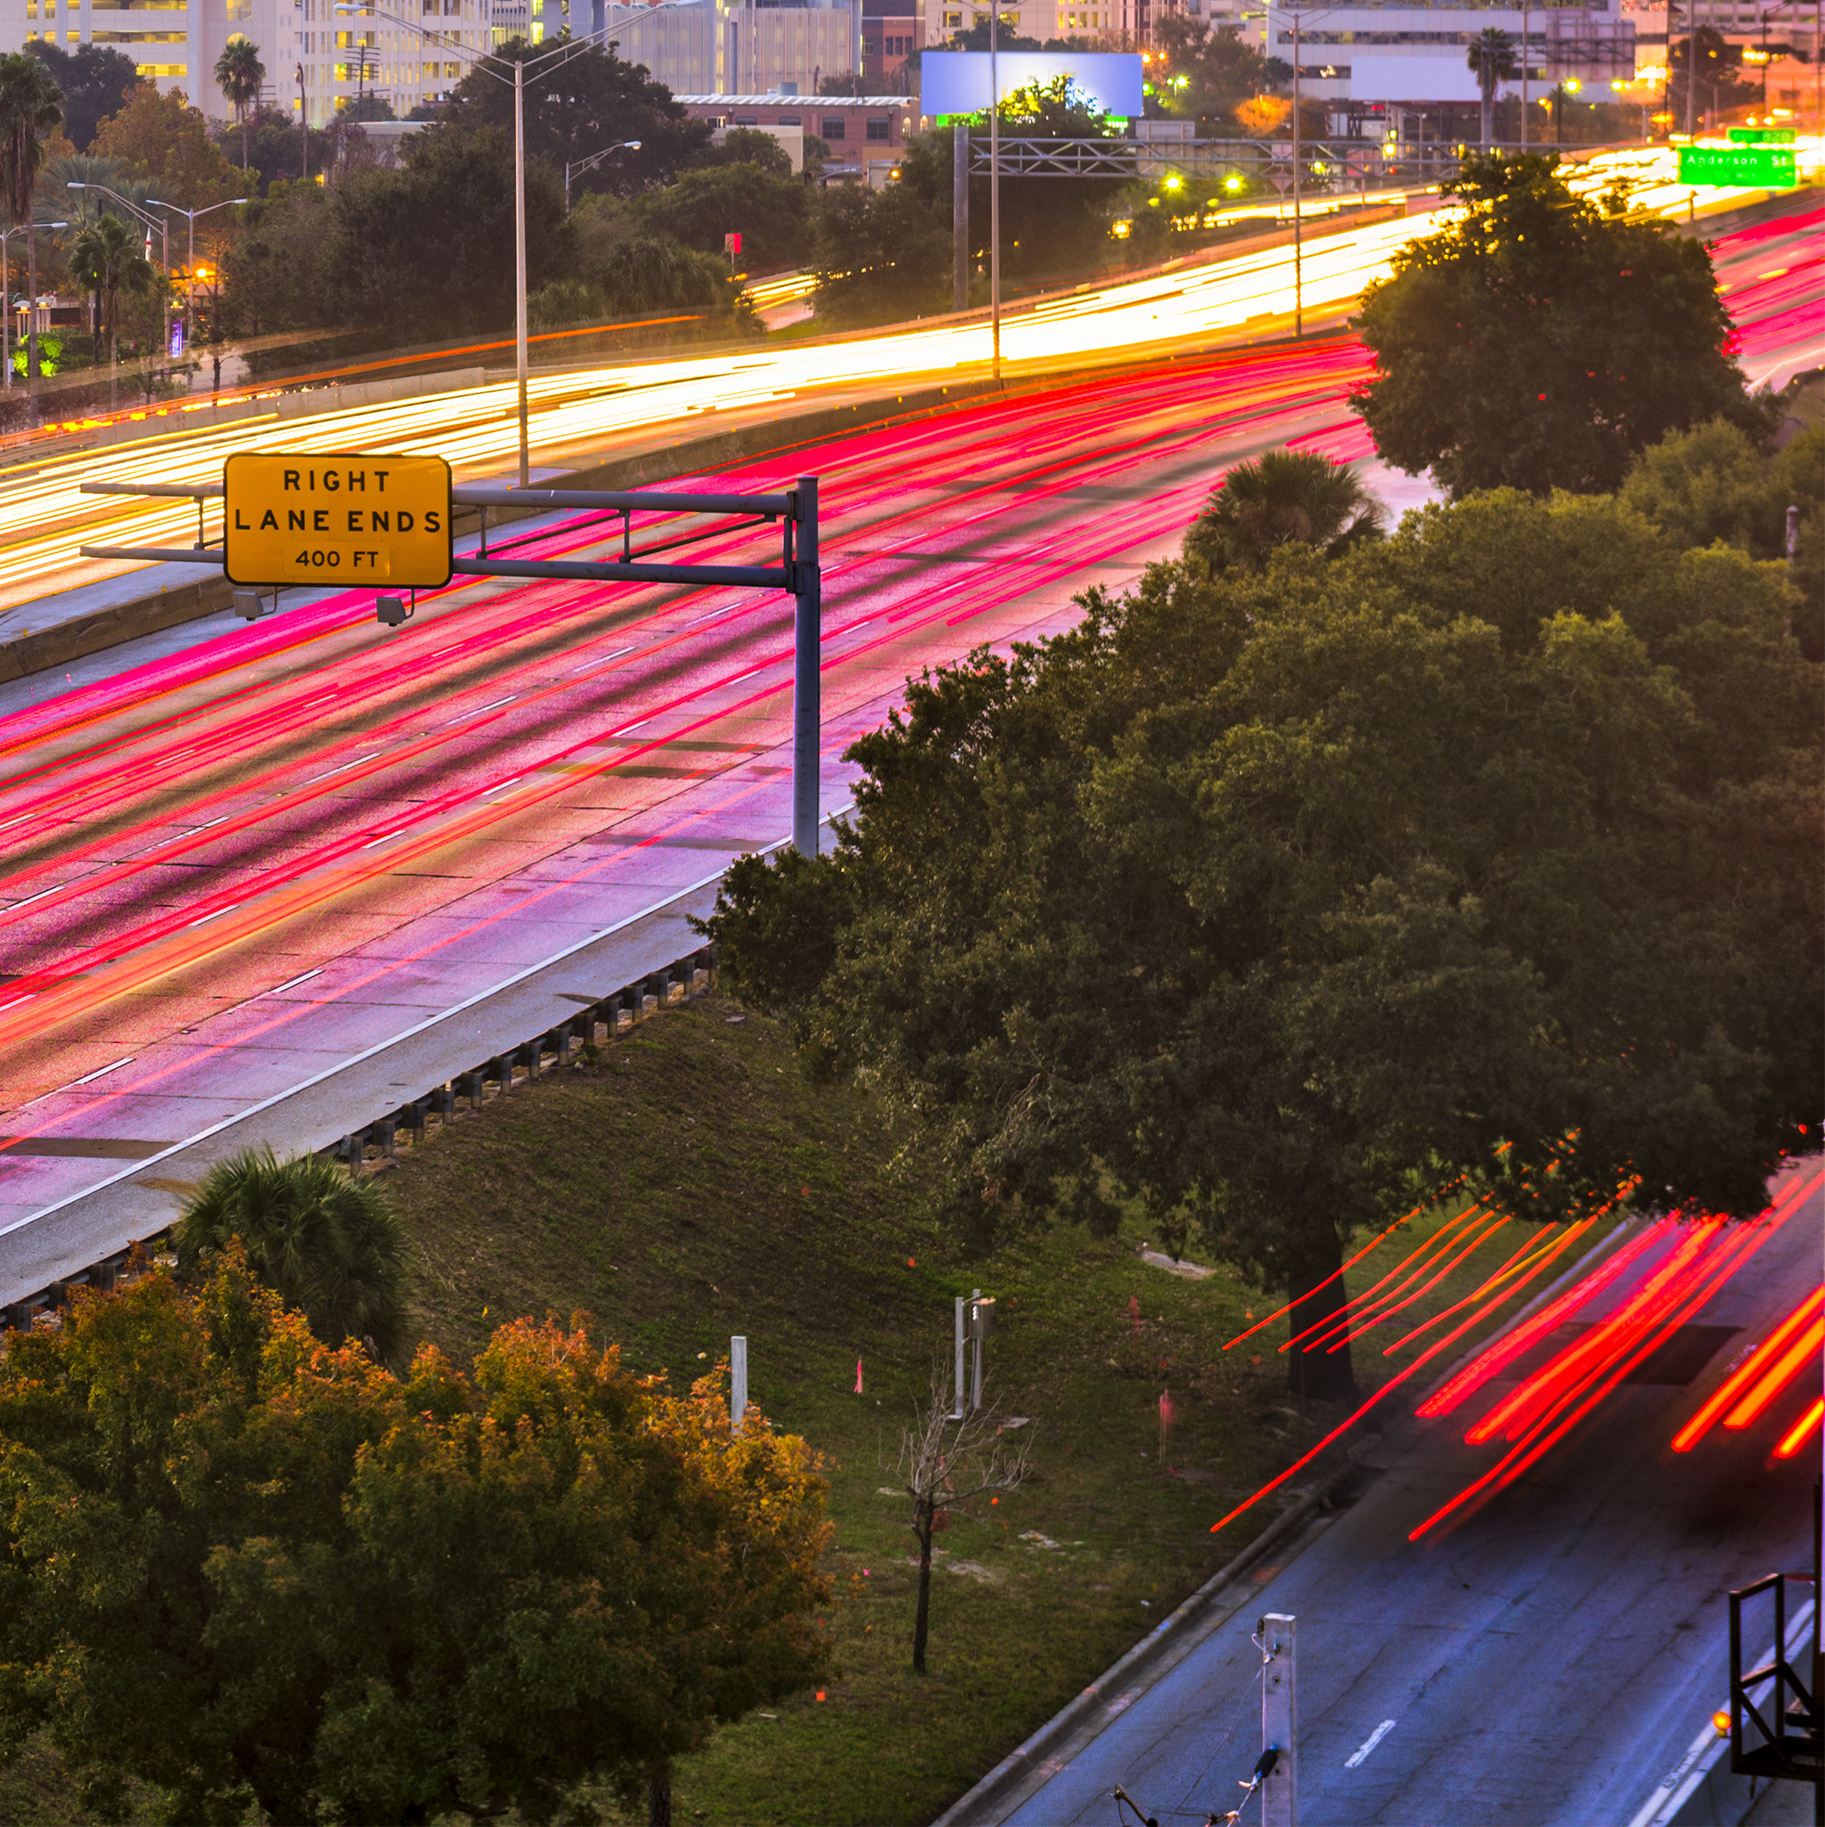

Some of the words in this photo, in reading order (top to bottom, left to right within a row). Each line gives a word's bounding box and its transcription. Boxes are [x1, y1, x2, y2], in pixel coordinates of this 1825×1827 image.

[1687, 154, 1757, 165] Anderson
[1771, 154, 1787, 167] St
[285, 470, 388, 491] RIGHT
[236, 509, 329, 531] LANE
[348, 511, 440, 532] ENDS
[296, 551, 340, 567] 400
[354, 552, 378, 567] FT
